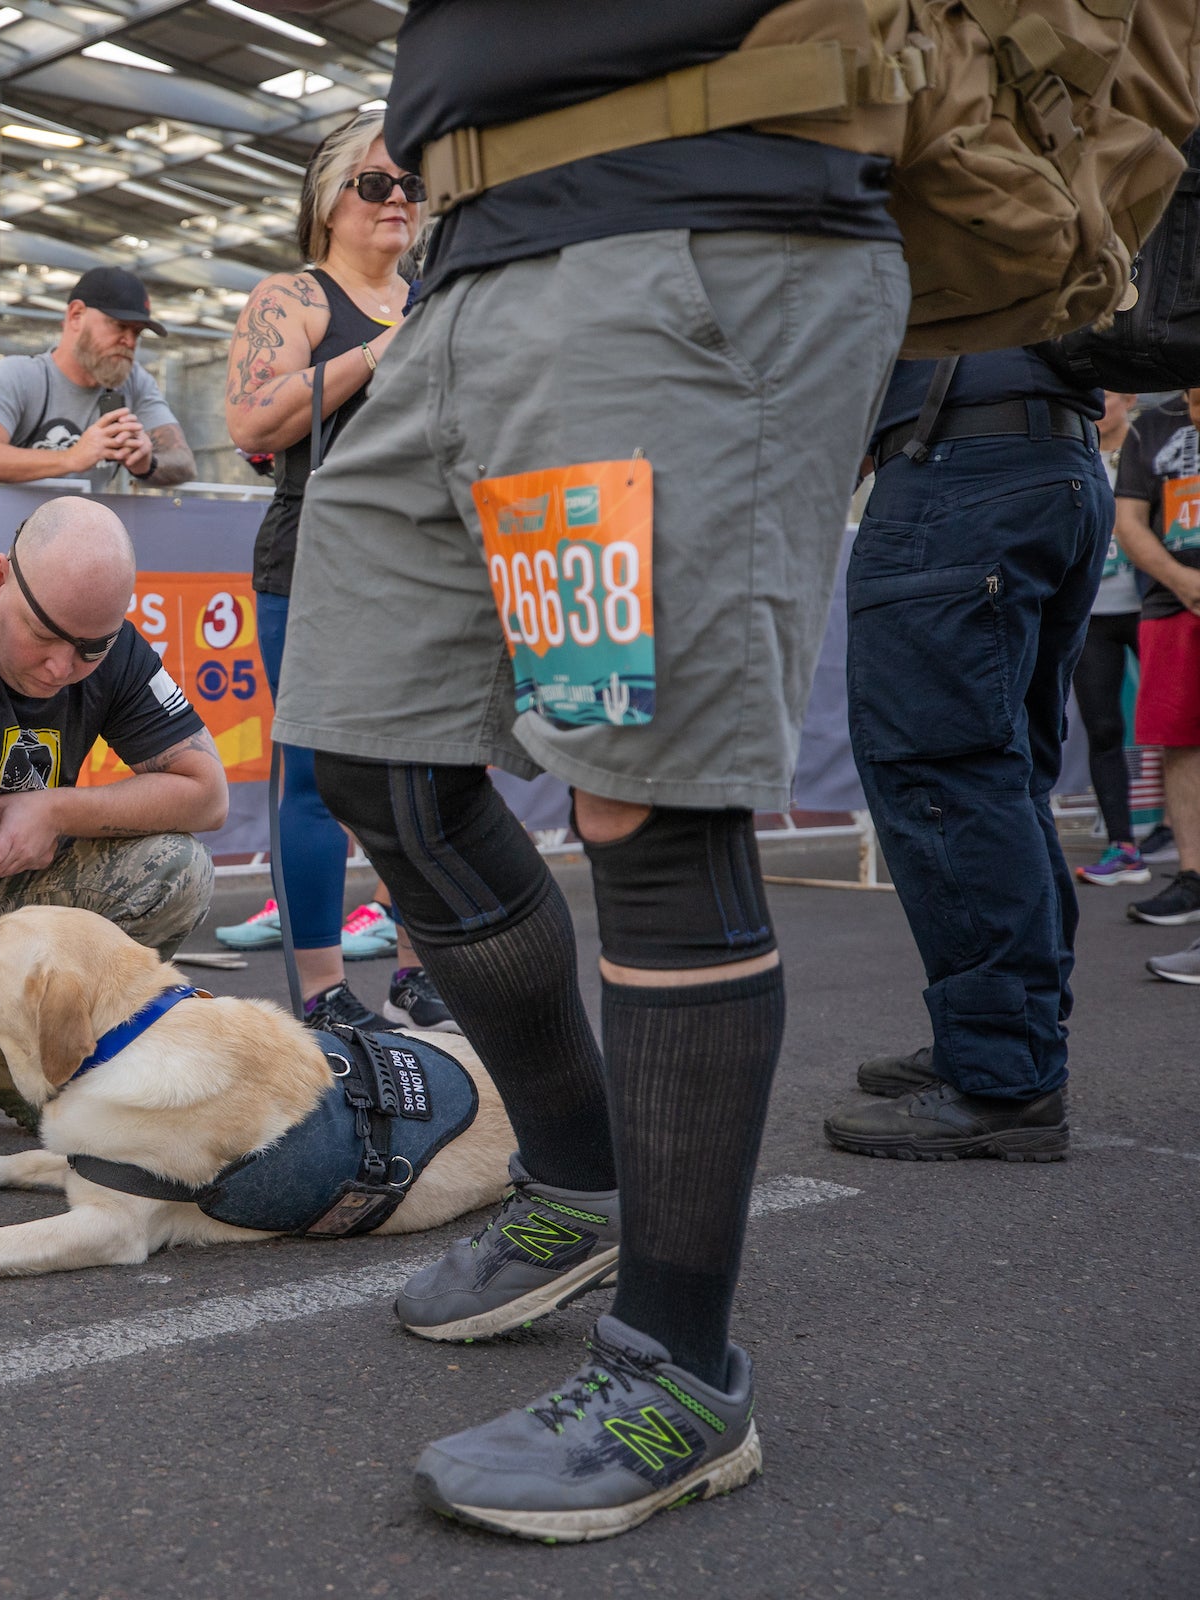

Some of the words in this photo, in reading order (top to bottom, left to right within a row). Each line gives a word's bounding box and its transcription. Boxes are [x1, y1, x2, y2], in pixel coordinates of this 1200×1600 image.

[490, 541, 641, 646] 26638
[203, 591, 238, 649] 3
[232, 660, 257, 701] 5
[389, 1049, 405, 1068] Dog
[402, 1052, 419, 1070] PET
[399, 1070, 415, 1111] Service
[409, 1070, 425, 1093] NOT
[414, 1094, 427, 1111] DO
